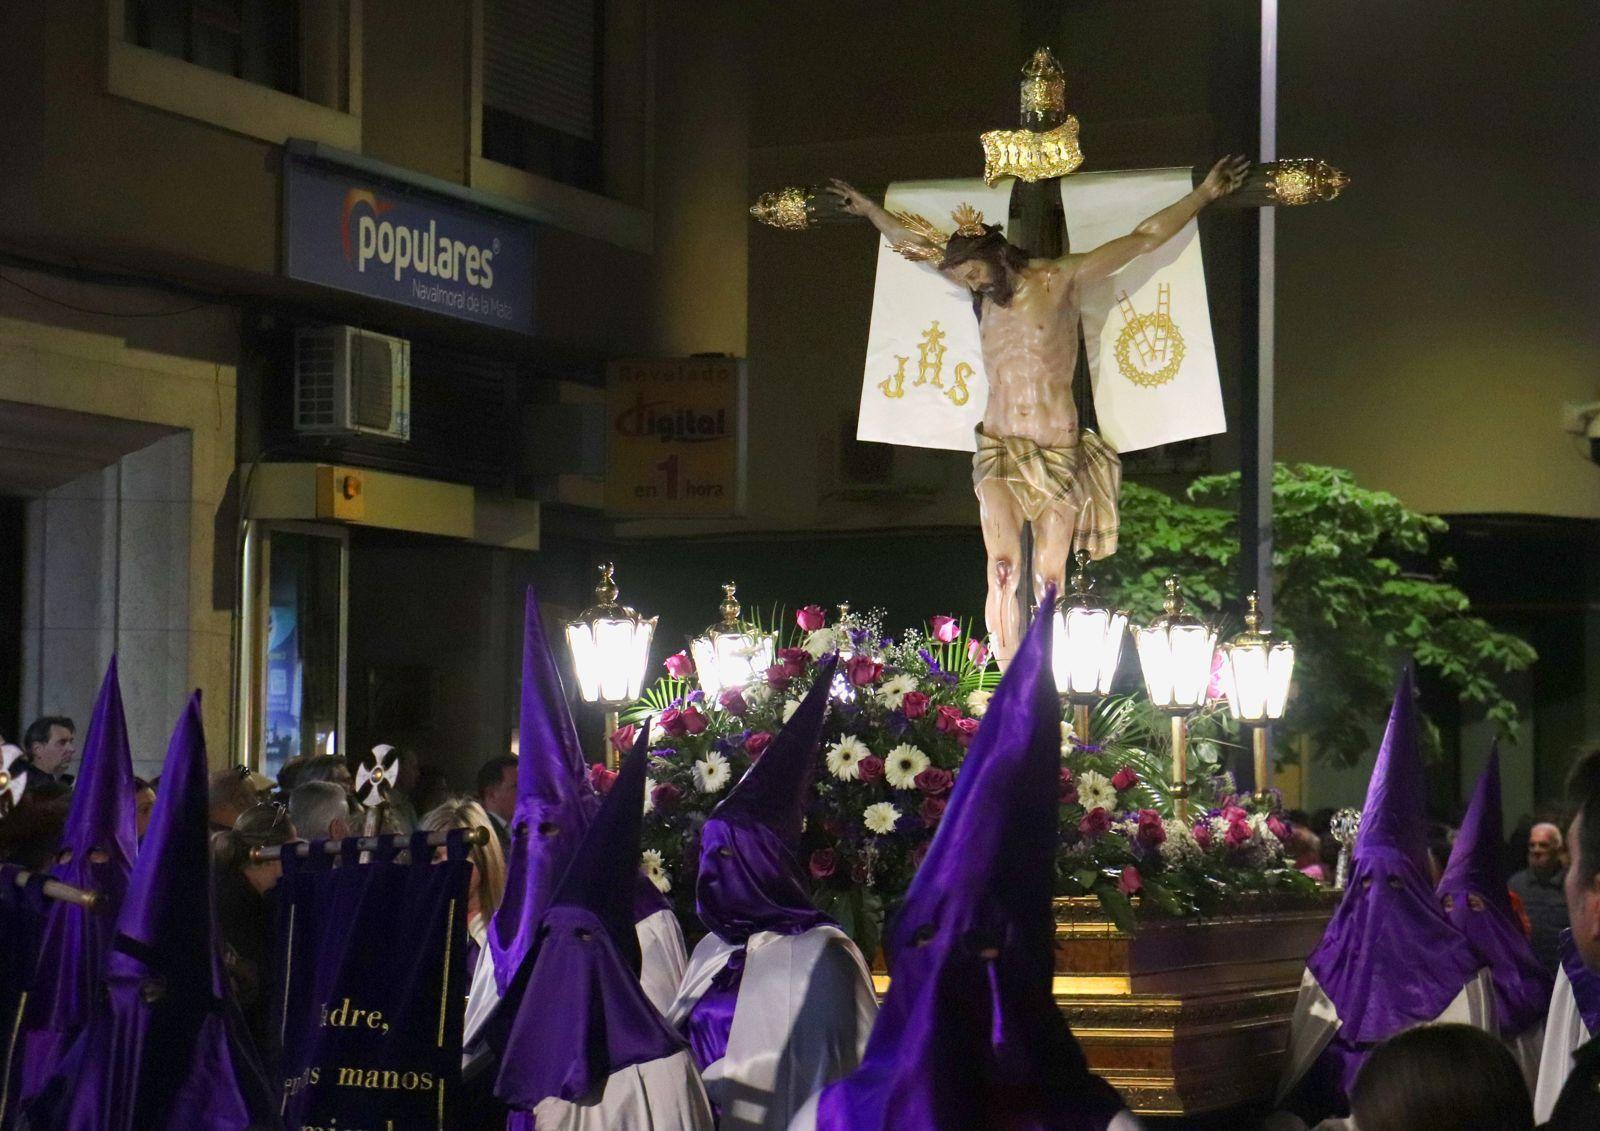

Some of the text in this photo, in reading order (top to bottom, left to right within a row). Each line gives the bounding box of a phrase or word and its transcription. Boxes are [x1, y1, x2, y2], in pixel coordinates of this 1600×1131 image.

[358, 215, 494, 289] populares
[411, 278, 465, 309] Navalmoral
[467, 293, 480, 313] de
[481, 293, 490, 315] la
[634, 454, 724, 498] en 1 hora
[336, 1066, 433, 1090] manos
